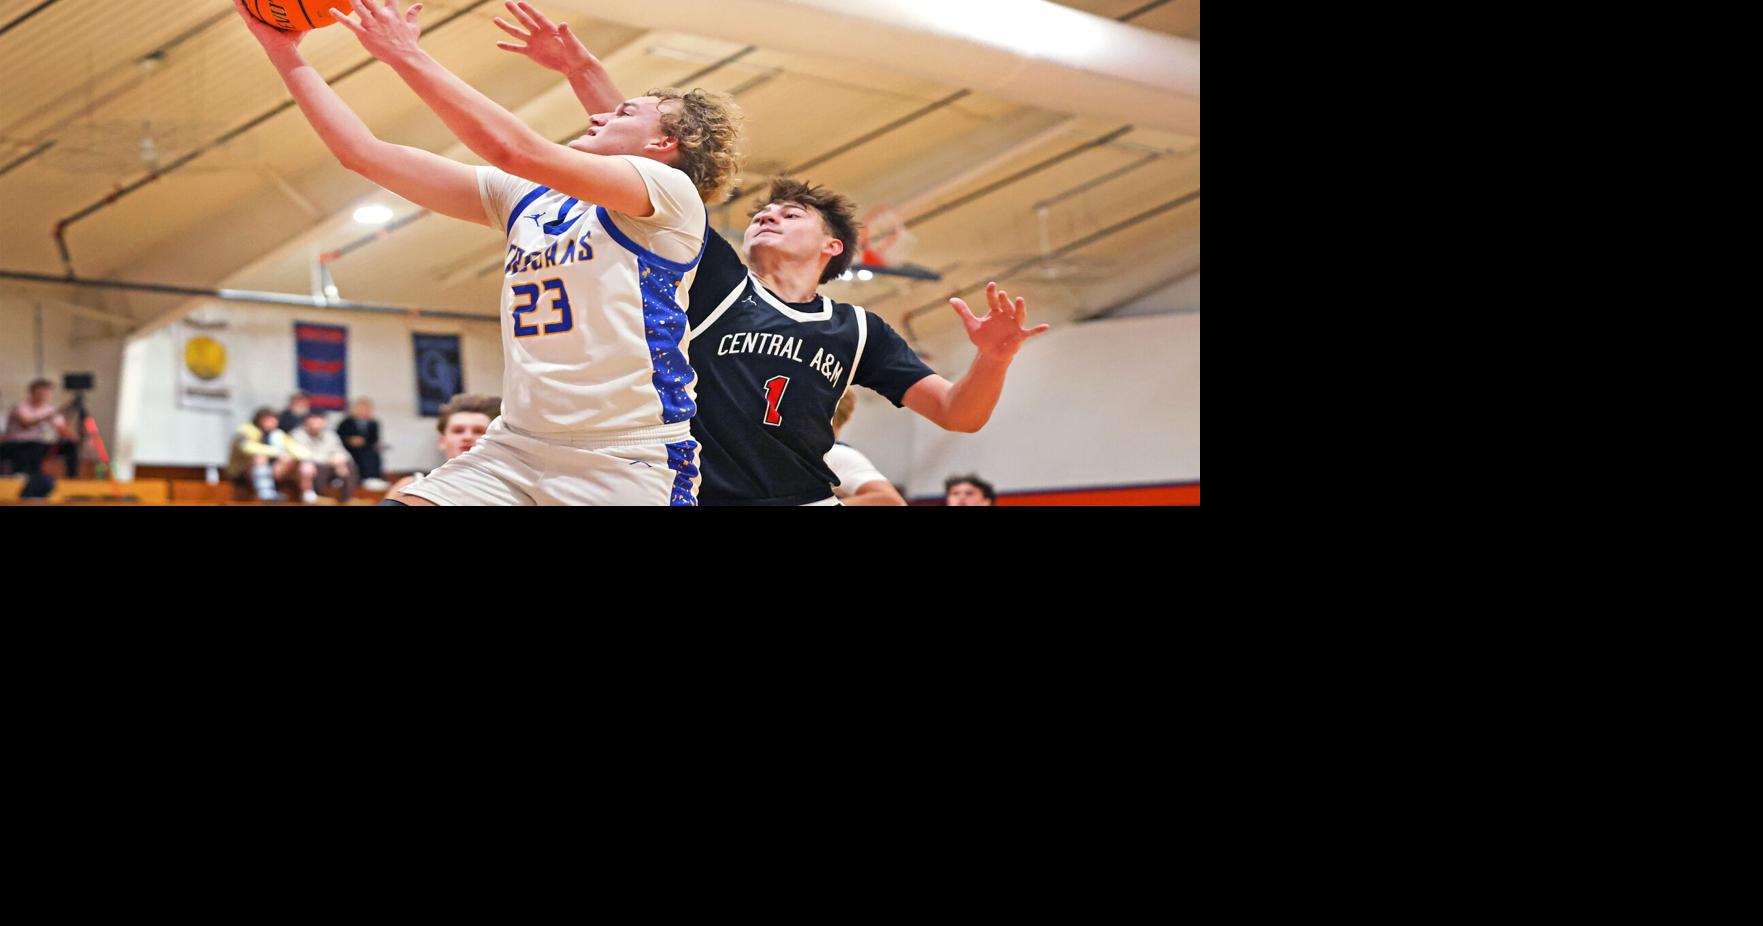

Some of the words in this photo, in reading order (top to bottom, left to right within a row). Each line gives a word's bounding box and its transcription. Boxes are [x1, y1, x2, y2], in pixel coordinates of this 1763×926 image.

[511, 276, 574, 338] 23
[717, 332, 803, 362] CENTRAL
[809, 347, 843, 388] A&M
[763, 374, 790, 427] 1
